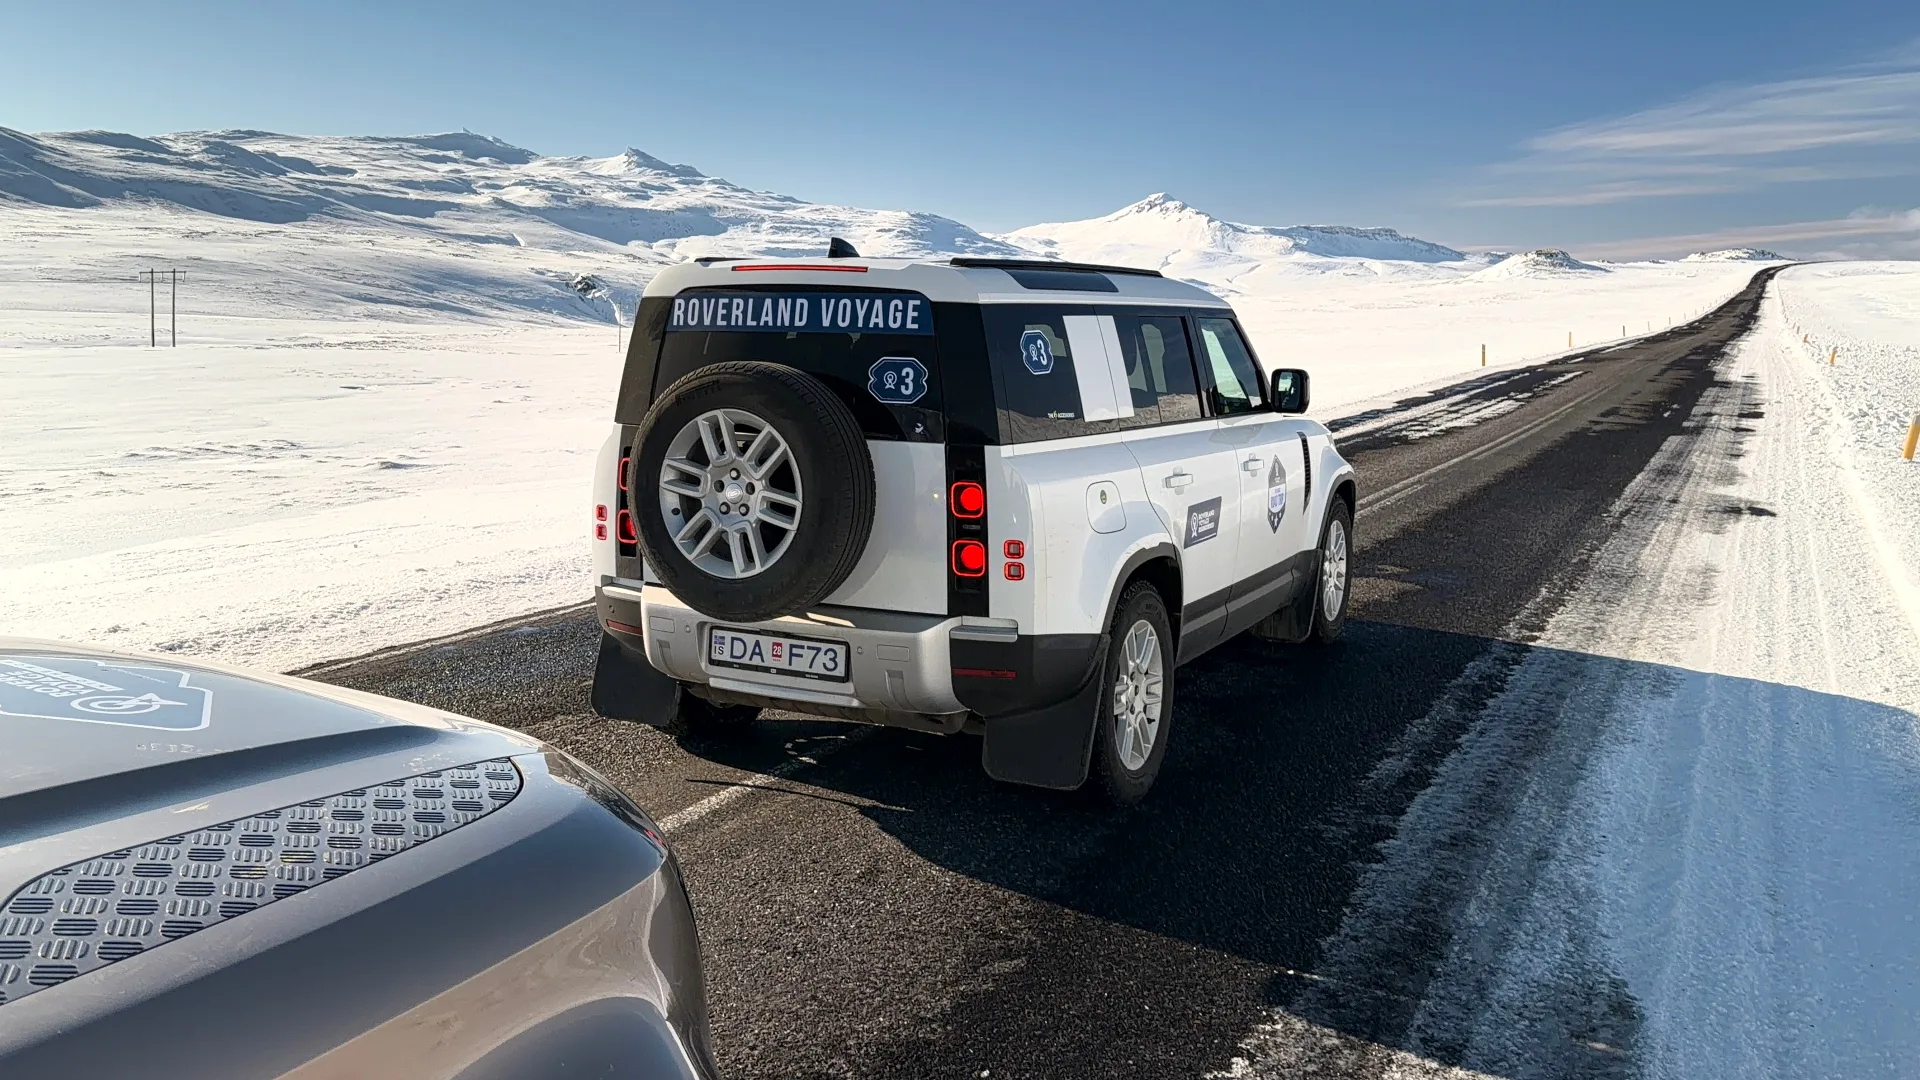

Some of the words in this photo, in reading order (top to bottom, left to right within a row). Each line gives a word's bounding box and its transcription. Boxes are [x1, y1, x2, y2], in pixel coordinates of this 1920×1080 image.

[673, 297, 809, 326] ROVERLAND
[821, 299, 921, 329] VOYAGE
[1036, 339, 1048, 366] 3
[900, 367, 914, 395] 3
[714, 645, 724, 655] IS
[729, 636, 765, 663] DA
[772, 645, 782, 656] 28
[788, 643, 839, 672] F73
